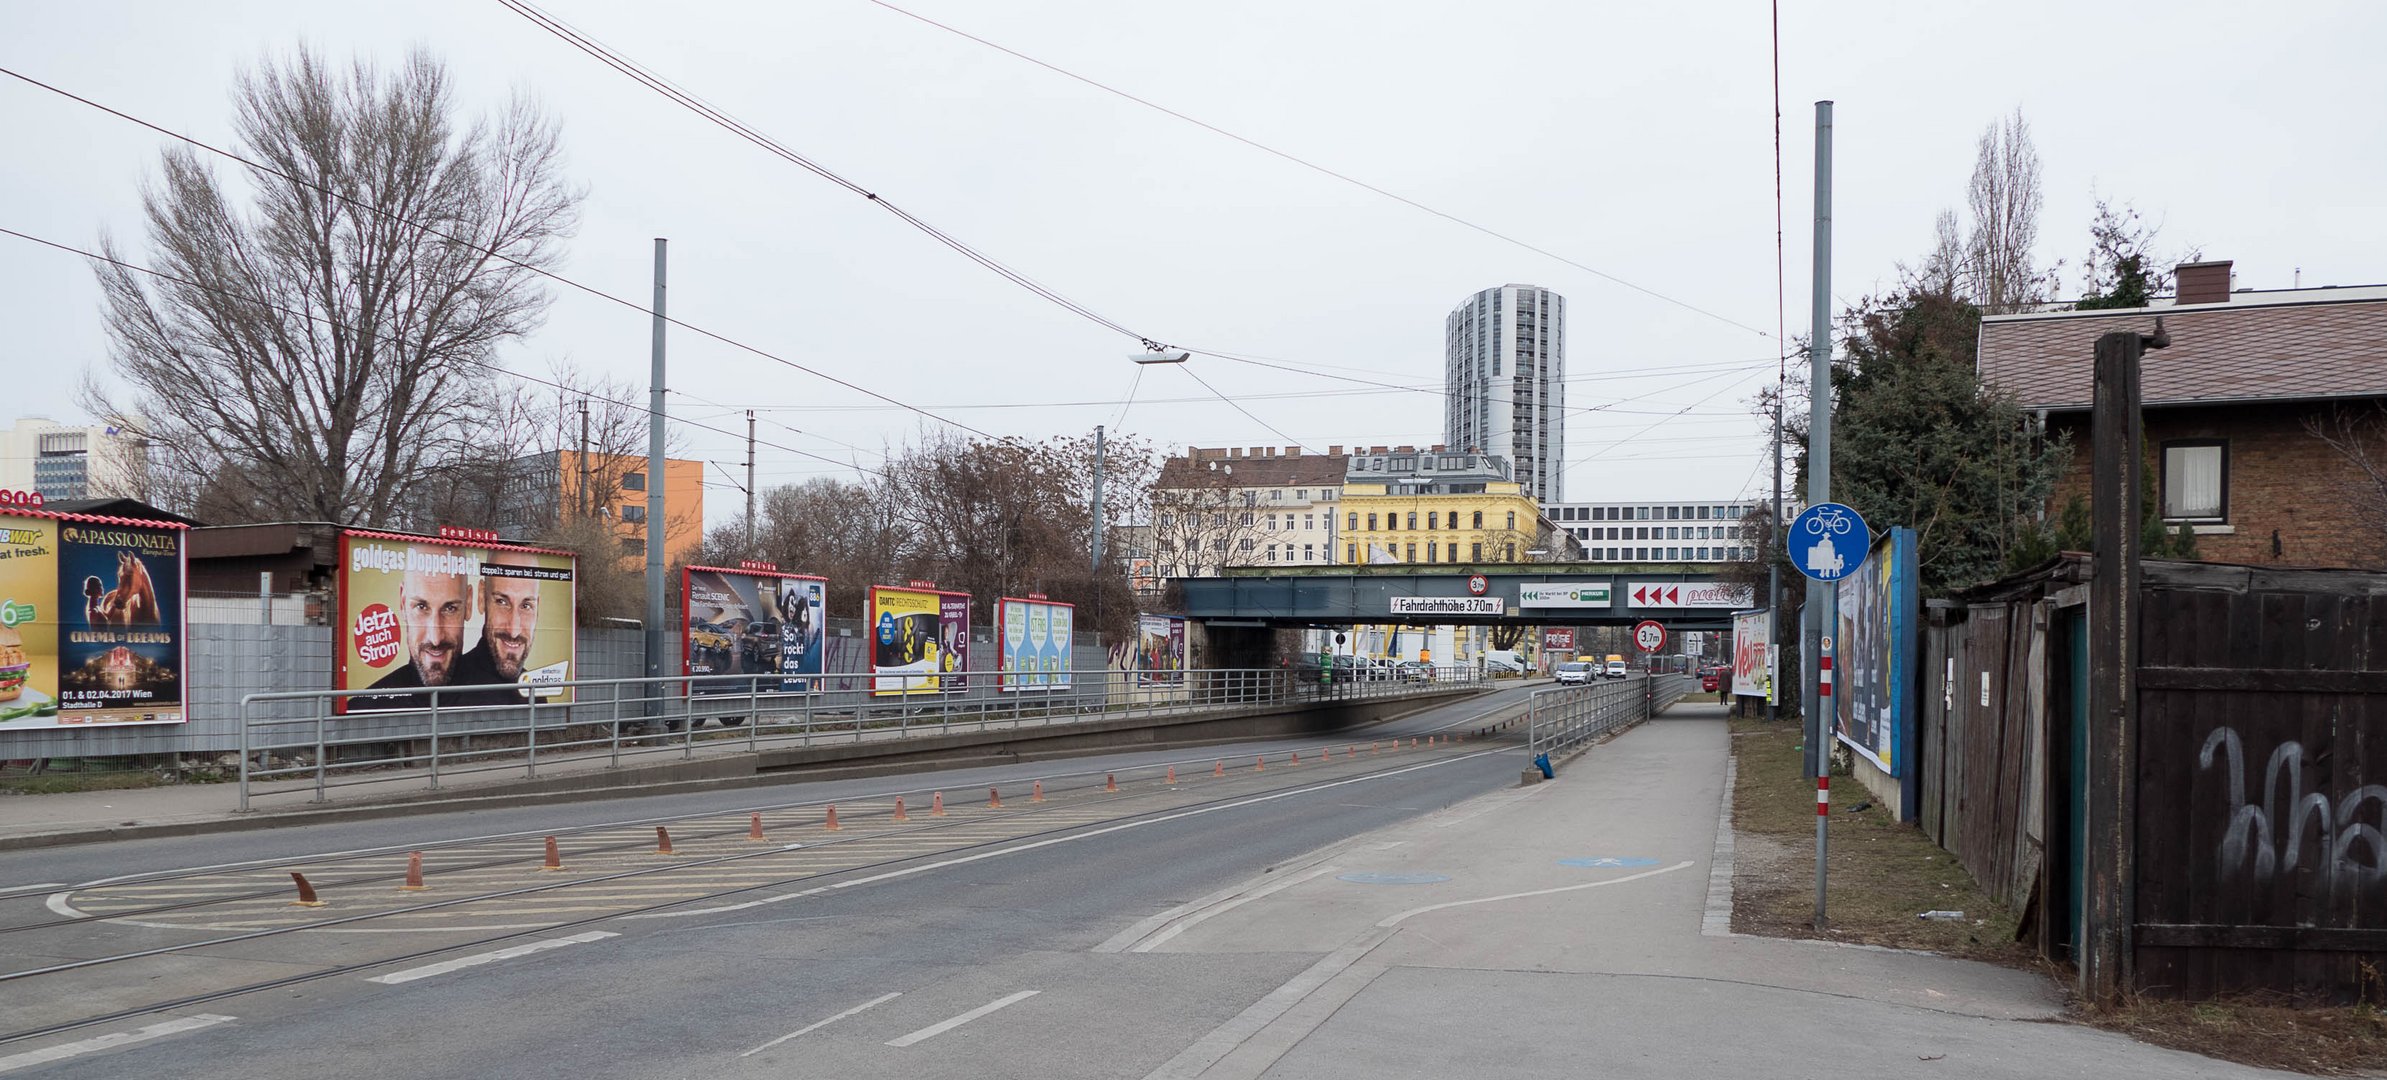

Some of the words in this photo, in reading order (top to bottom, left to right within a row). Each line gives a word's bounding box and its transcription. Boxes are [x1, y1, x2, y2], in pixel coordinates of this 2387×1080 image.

[78, 529, 177, 550] APASSIONATA
[441, 526, 498, 541] gewista
[15, 546, 50, 557] fresh.
[353, 543, 405, 574] goldgas
[406, 547, 481, 579] Doppelpack
[481, 566, 503, 575] doppelt
[505, 568, 523, 577] sparen
[524, 569, 533, 577] bei
[534, 570, 549, 579] strom
[550, 571, 559, 579] und
[559, 572, 571, 581] gas!
[809, 592, 820, 602] 886
[1400, 599, 1465, 612] Fahrdrahthöhe
[354, 608, 396, 636] Jetzt
[71, 631, 116, 643] CINEMA
[127, 631, 172, 644] DREAMS
[365, 628, 392, 646] auch
[783, 629, 794, 642] So
[360, 641, 400, 664] Strom
[783, 643, 805, 655] rockt
[783, 657, 799, 669] das
[62, 691, 77, 700] 01.
[77, 691, 85, 700] &
[86, 689, 131, 699] 02.04.2017
[132, 690, 153, 699] Wien
[62, 701, 96, 709] Stadthalle
